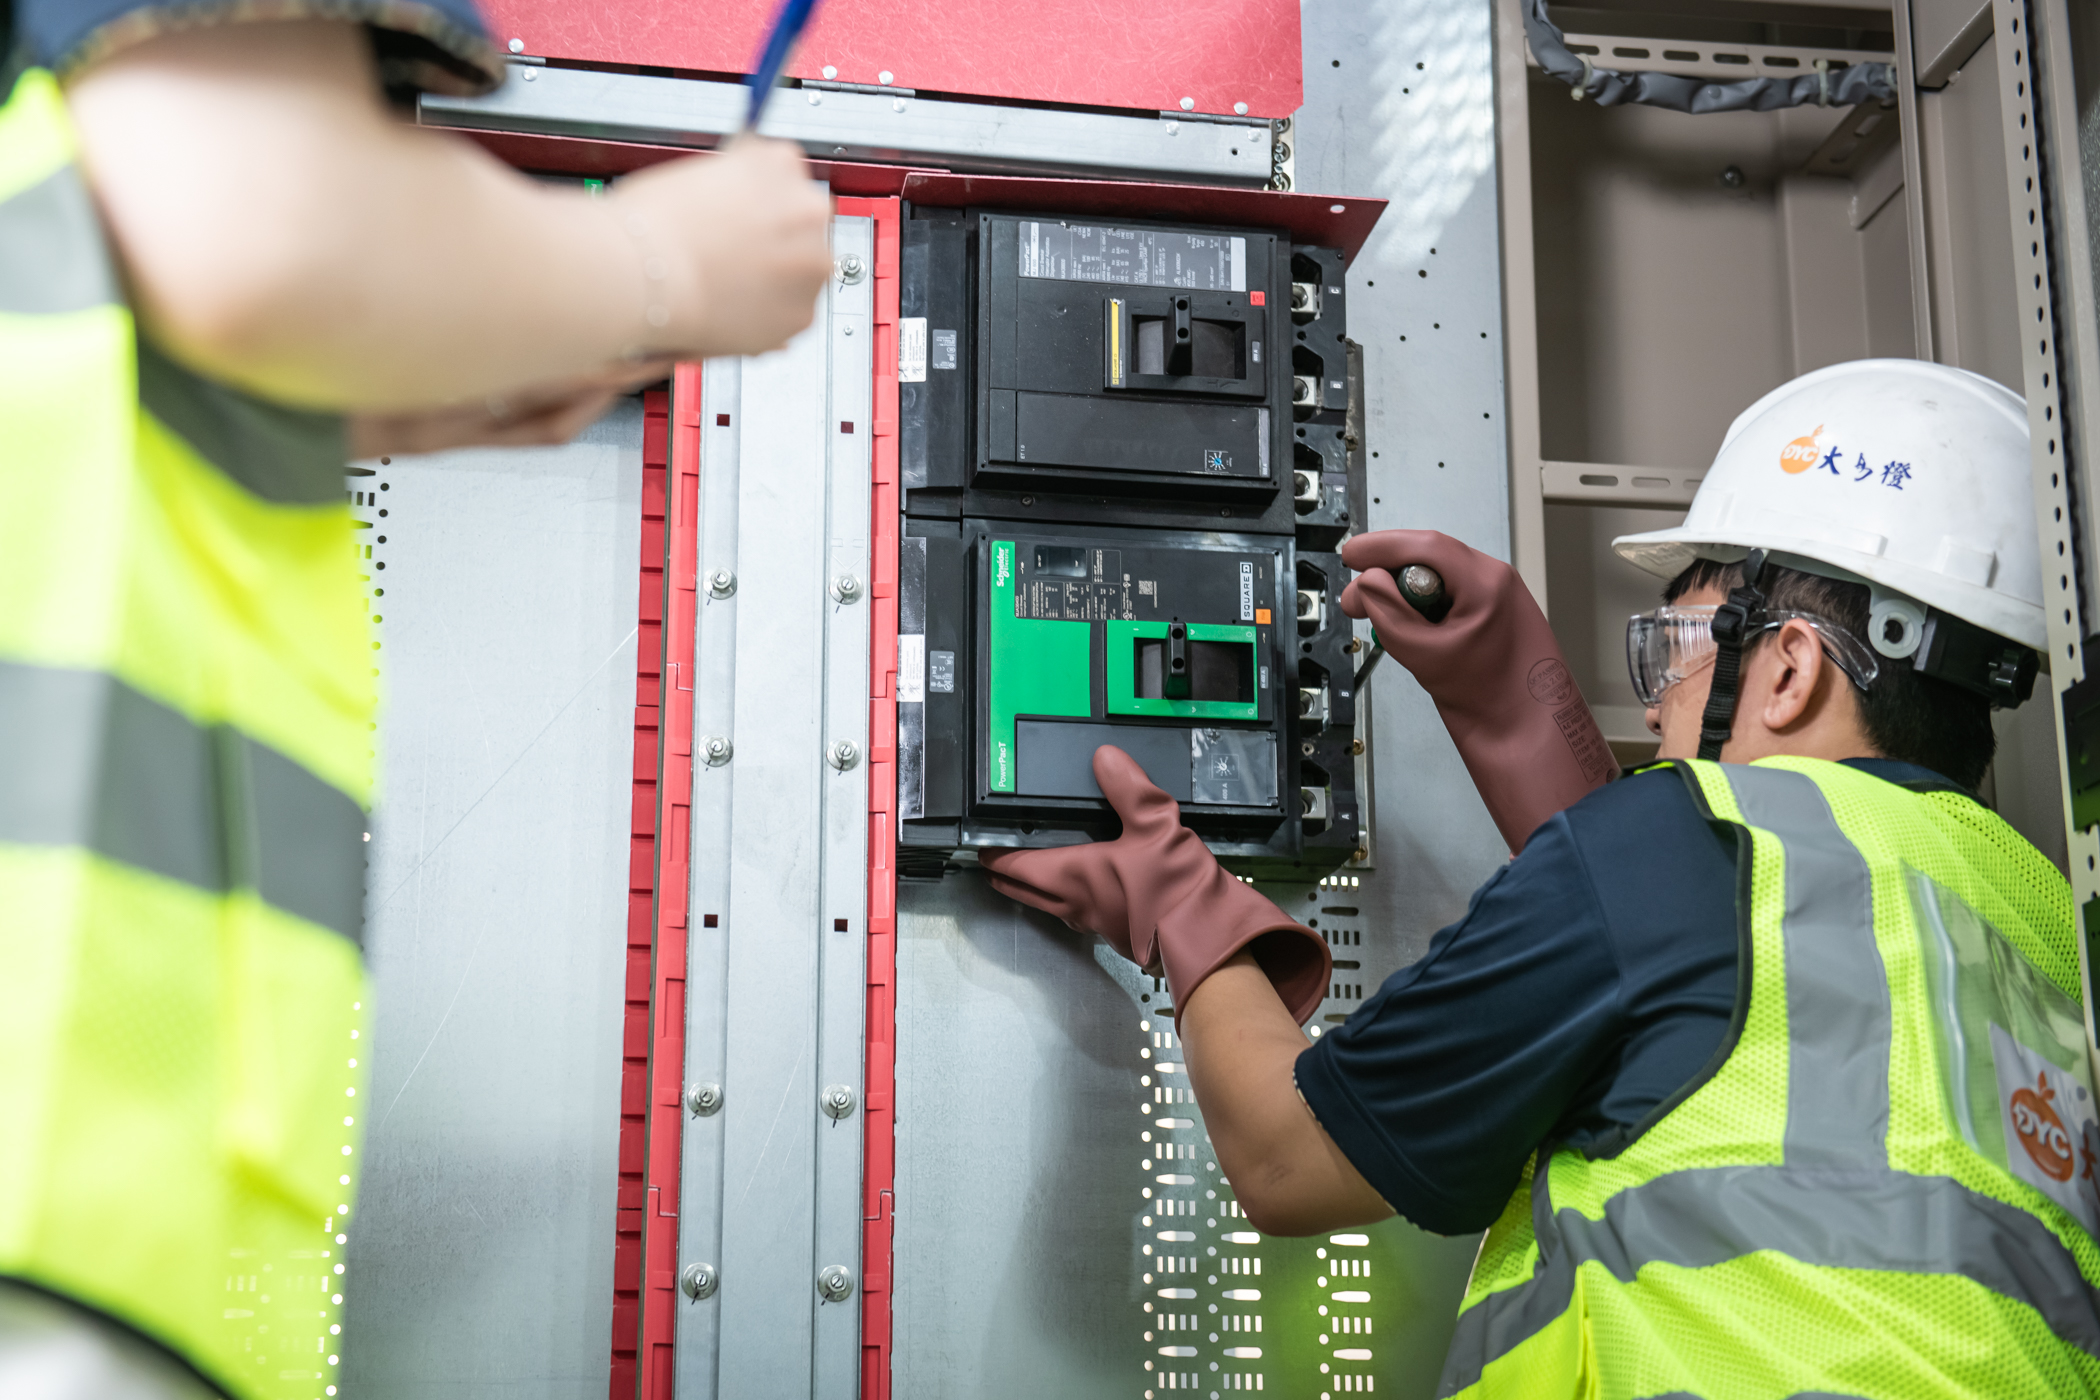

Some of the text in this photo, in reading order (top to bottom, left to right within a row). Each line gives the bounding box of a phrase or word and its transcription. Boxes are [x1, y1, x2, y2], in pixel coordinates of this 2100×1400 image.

[996, 547, 1009, 587] Schneider
[1242, 564, 1251, 573] D
[1567, 729, 1578, 739] MAX
[2013, 1101, 2070, 1160] DYC
